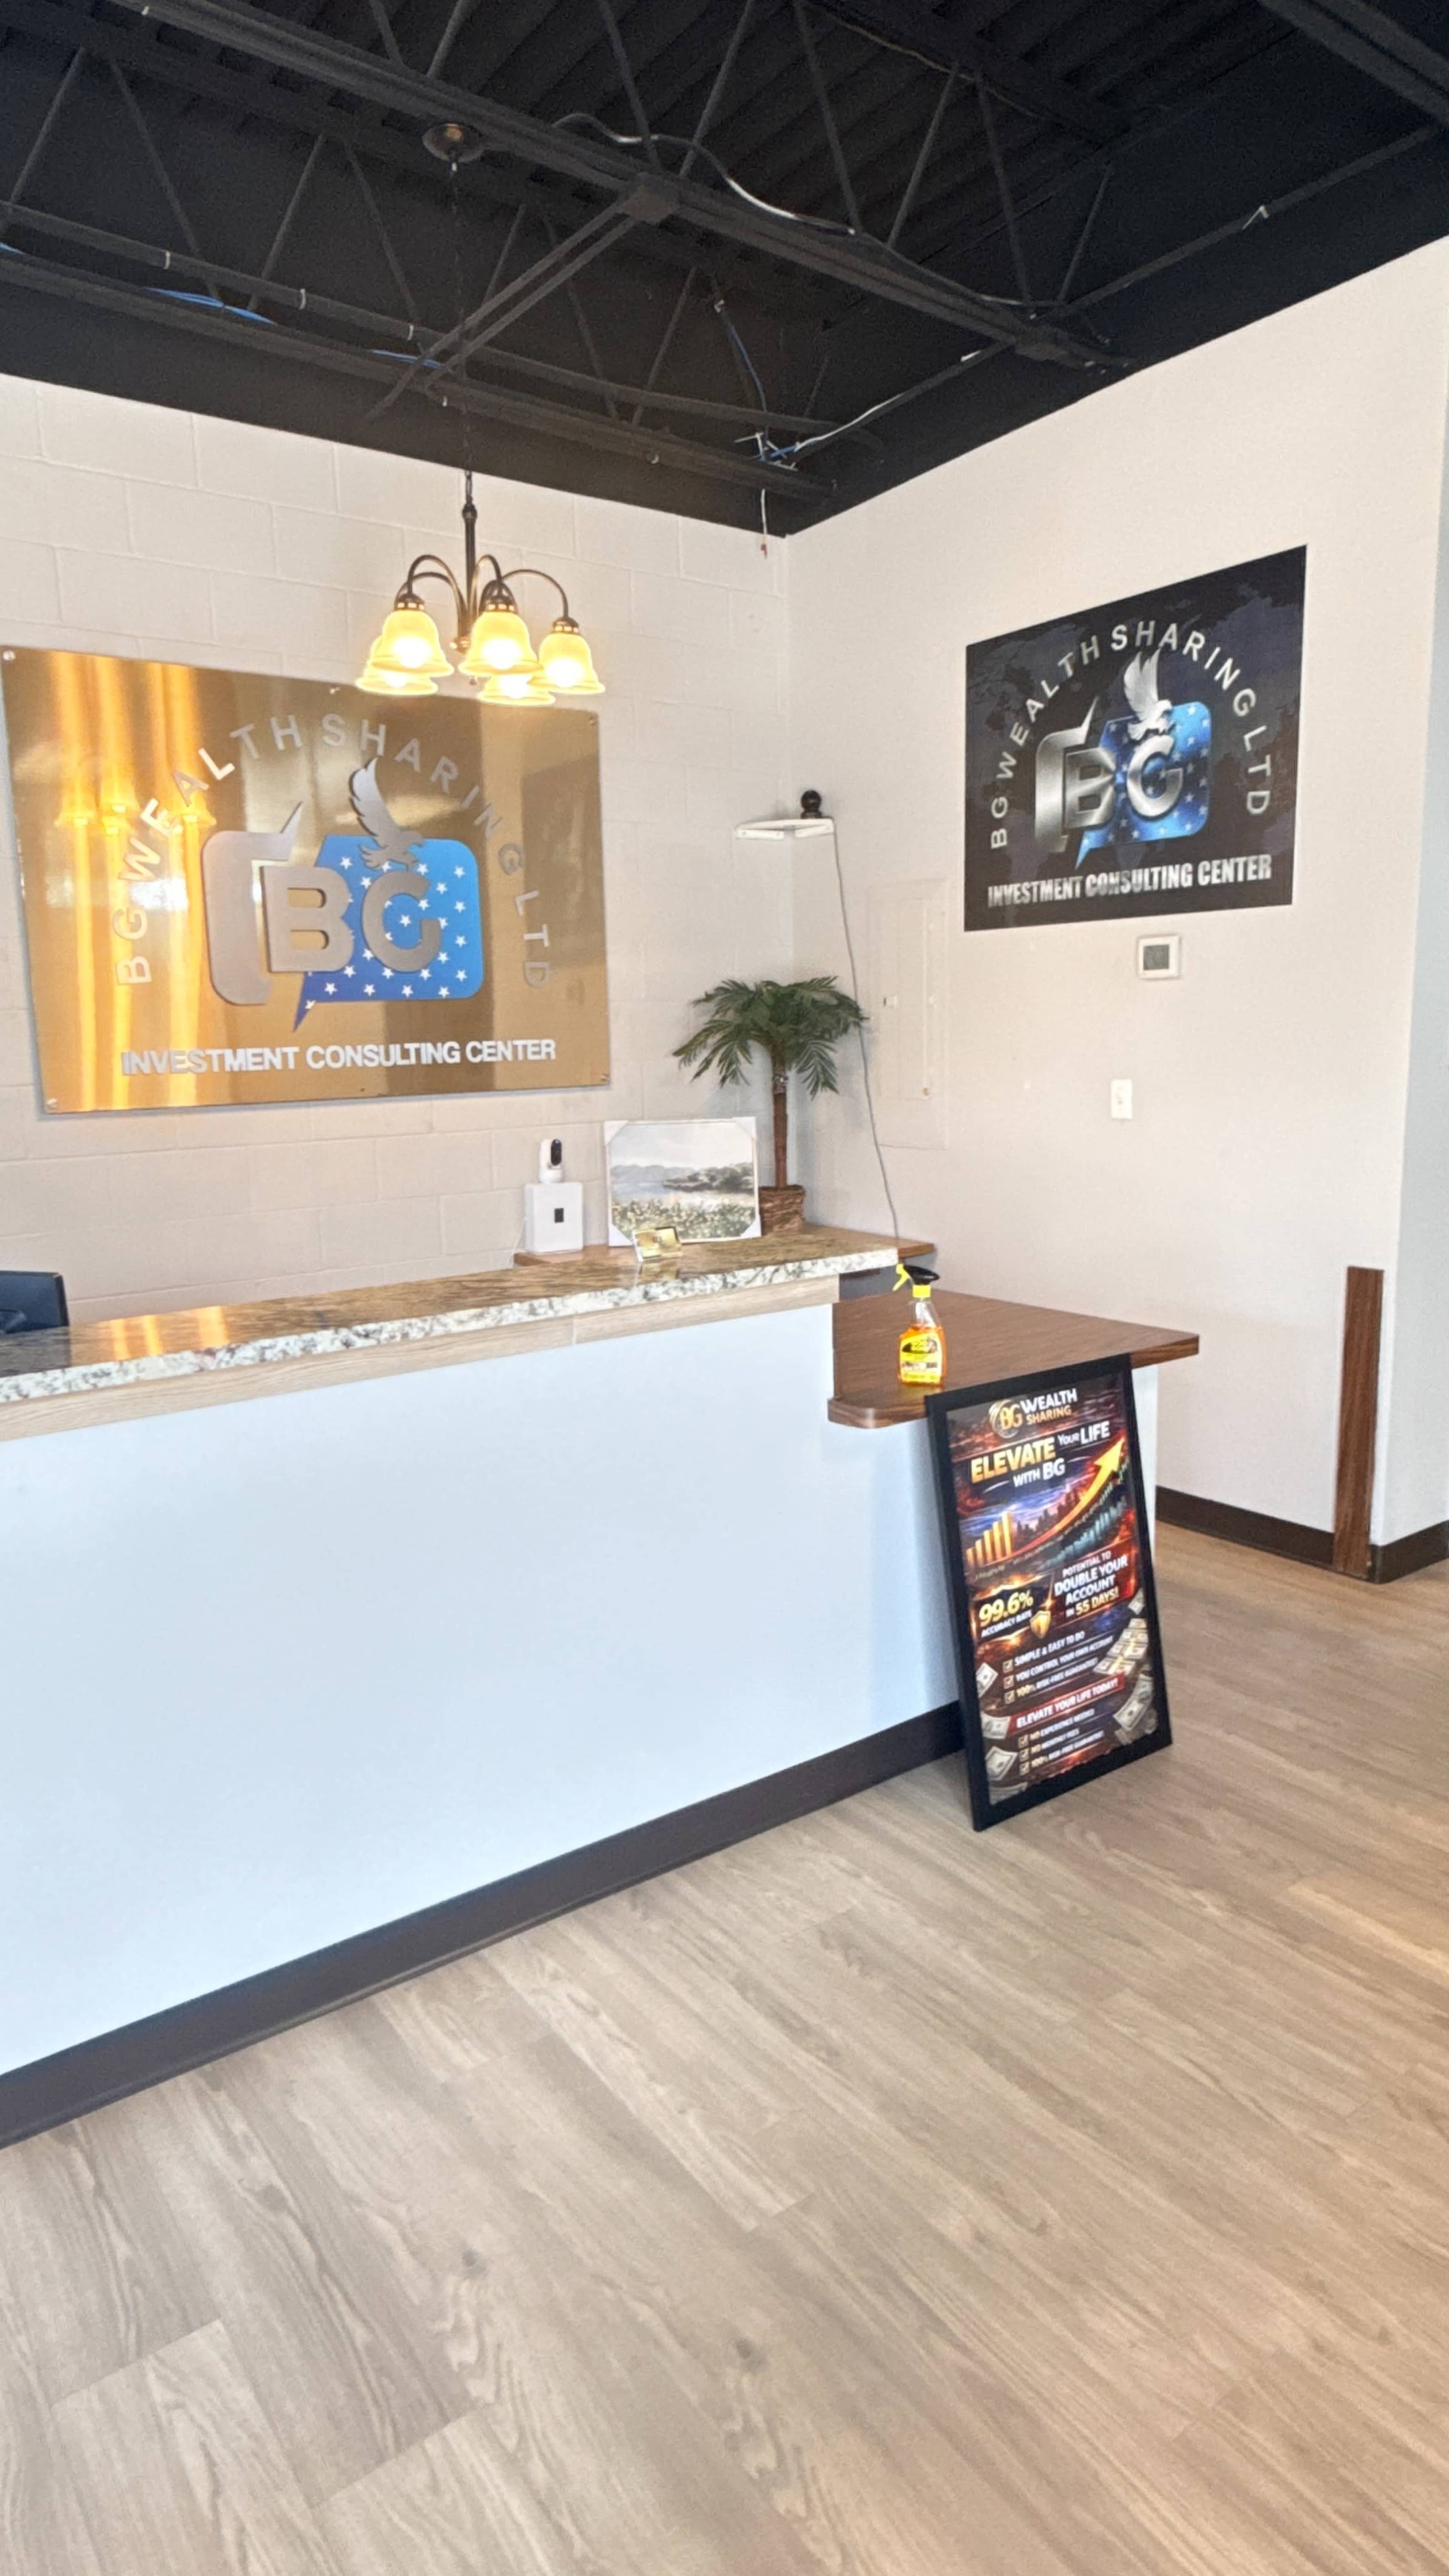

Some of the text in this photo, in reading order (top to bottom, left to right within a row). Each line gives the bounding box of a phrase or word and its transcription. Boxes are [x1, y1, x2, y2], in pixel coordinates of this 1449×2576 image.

[991, 621, 1271, 849] BG WEALTH SHARING LTD
[1064, 735, 1183, 828] BG
[112, 713, 551, 987] BG WEALTH SHARING LTD
[988, 854, 1272, 908] INVESTMENT CONSULTING CENTER
[260, 866, 443, 973] BG
[121, 1039, 555, 1075] INVESTMENT CONSULTING CENTER
[1000, 1404, 1022, 1430] BG
[1020, 1388, 1077, 1413] WEALTH
[1026, 1405, 1071, 1425] SHARING
[971, 1437, 1056, 1484] ELEVATE
[1080, 1421, 1110, 1444] LIFE
[1013, 1458, 1065, 1487] WITH BG
[1054, 1555, 1128, 1596] DOUBLE YOUR
[1062, 1550, 1111, 1578] POTENTIAL TO
[1065, 1575, 1115, 1606] ACCOUNT
[1075, 1599, 1090, 1616] 55
[1091, 1586, 1118, 1610] DAYS!
[979, 1590, 1034, 1628] 99.6%
[981, 1609, 1032, 1638] ACCURACY RATE
[1014, 1647, 1041, 1666] SIMPLE
[1048, 1638, 1066, 1653] EASY
[1066, 1635, 1075, 1645] TO
[1075, 1630, 1085, 1641] DO
[1015, 1669, 1030, 1681] YOU
[1030, 1658, 1059, 1676] CONTROL
[1016, 1704, 1053, 1728] ELEVATE
[1054, 1696, 1075, 1712] YOUR
[1076, 1689, 1092, 1703] LIFE
